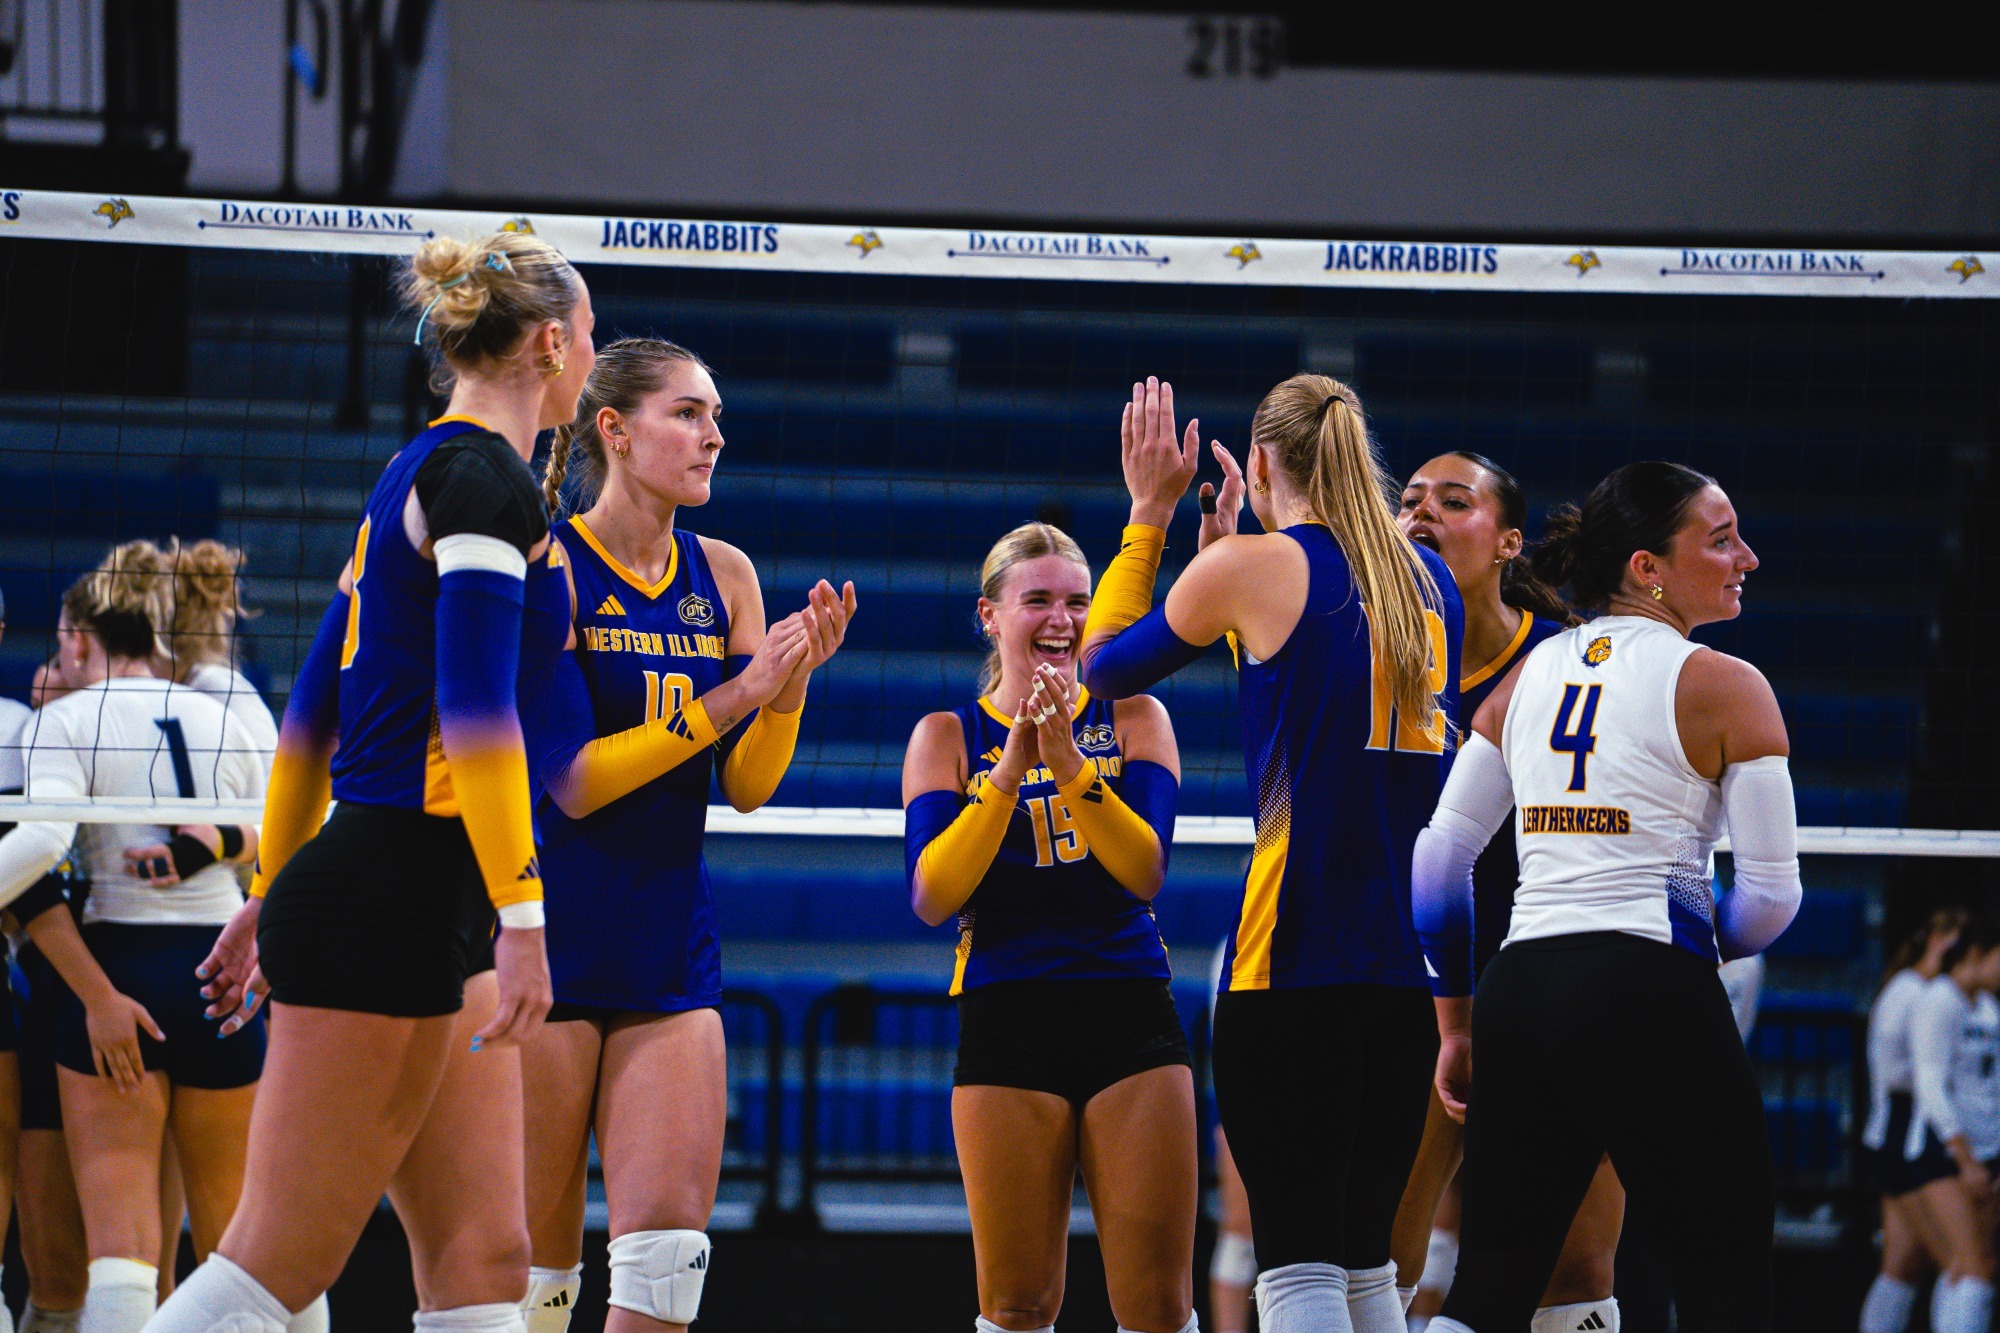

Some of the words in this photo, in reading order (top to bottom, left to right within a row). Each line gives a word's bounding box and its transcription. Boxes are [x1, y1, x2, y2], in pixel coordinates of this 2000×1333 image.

[221, 202, 338, 228] DACOTAH
[347, 207, 414, 231] BANK
[601, 219, 779, 253] JACKRABBITS
[968, 231, 1079, 254] DACOTAH
[1086, 234, 1152, 257] BANK
[1324, 244, 1498, 274] JACKRABBITS
[1680, 248, 1792, 270] DACOTAH
[1800, 251, 1865, 272] BANK
[583, 626, 665, 656] WESTERN
[666, 633, 725, 660] ILLINOS
[642, 670, 694, 725] 10
[1549, 681, 1604, 793] 4
[153, 717, 196, 798] 1
[1024, 794, 1089, 868] 15
[1521, 805, 1632, 836] LEATHERNECKS
